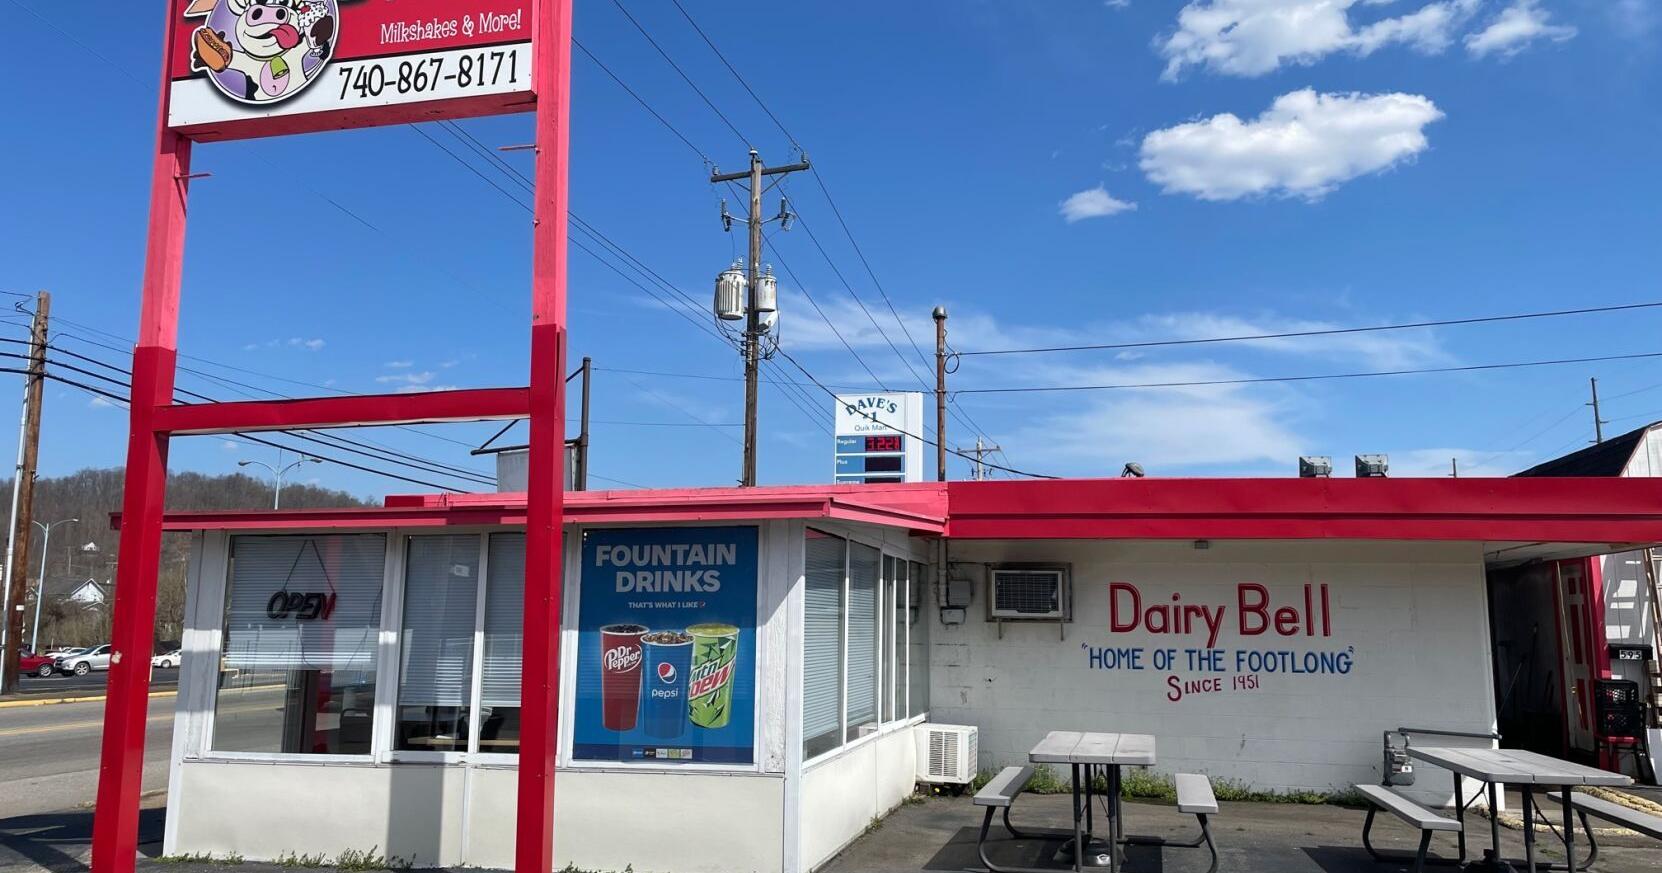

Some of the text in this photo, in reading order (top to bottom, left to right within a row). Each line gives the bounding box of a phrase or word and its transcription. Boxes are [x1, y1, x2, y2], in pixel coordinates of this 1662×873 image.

[380, 8, 522, 44] Milkshakes & More!
[338, 50, 519, 100] 740-867-8171
[845, 397, 898, 416] DAVE'S
[595, 544, 736, 567] FOUNTAIN
[615, 570, 721, 593] DRINKS
[266, 589, 337, 620] OPEN
[1108, 582, 1332, 649] Dairy Bell
[605, 648, 641, 670] Pepper
[617, 645, 632, 658] Dr
[1153, 648, 1178, 671] OF
[1185, 648, 1226, 672] THE
[1620, 650, 1641, 660] 595
[1233, 674, 1260, 690] 1951
[652, 688, 679, 700] pepsi
